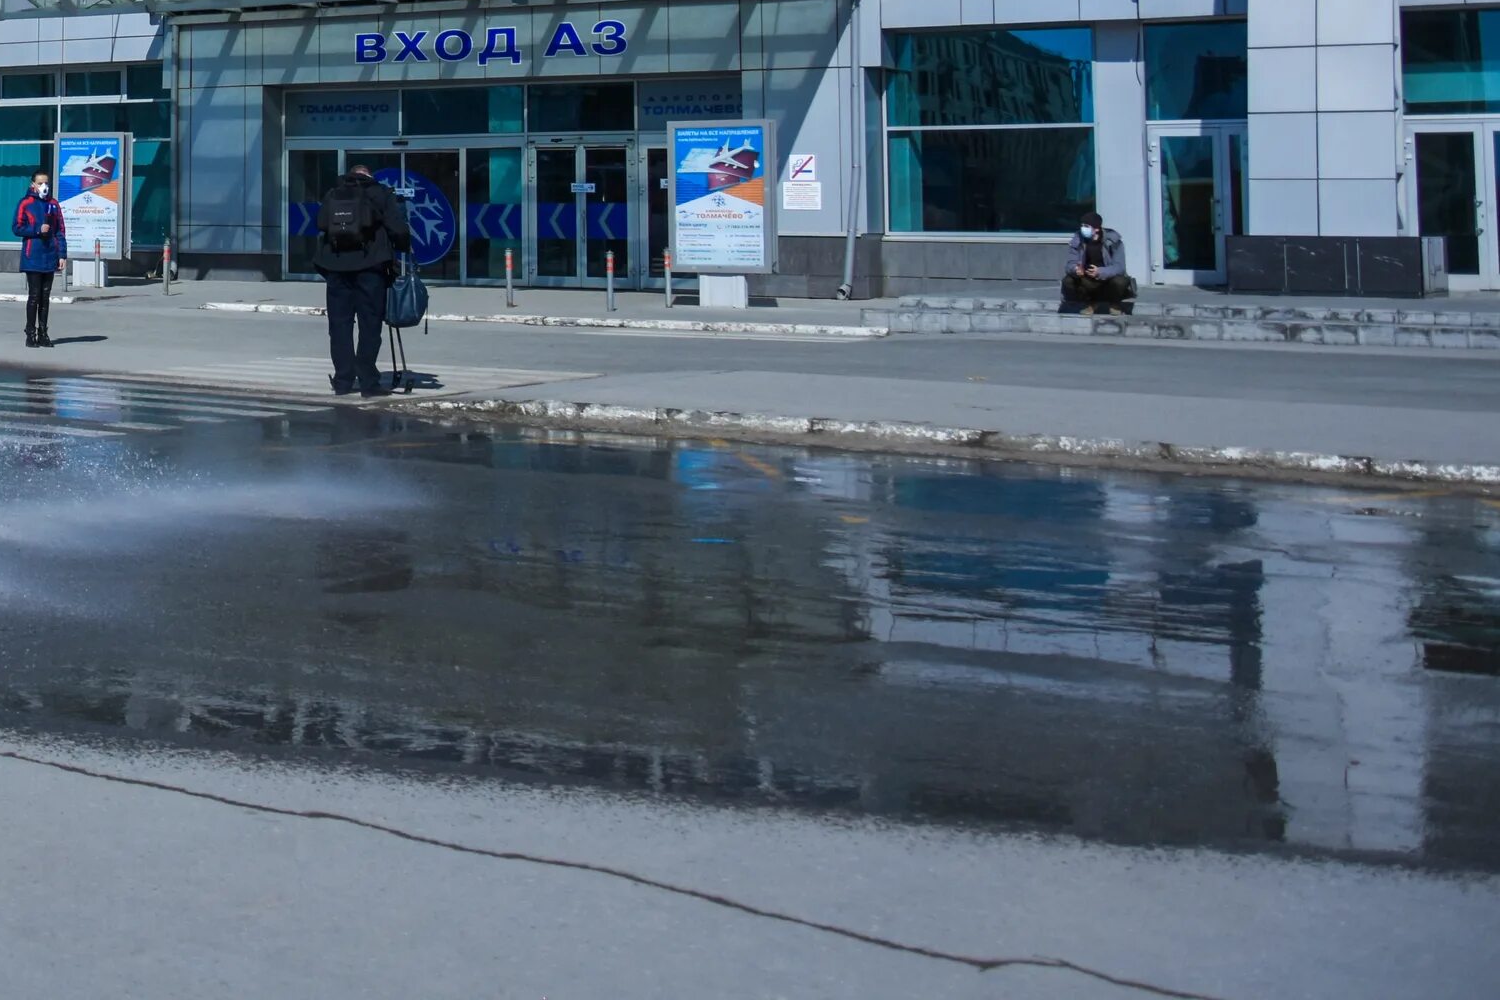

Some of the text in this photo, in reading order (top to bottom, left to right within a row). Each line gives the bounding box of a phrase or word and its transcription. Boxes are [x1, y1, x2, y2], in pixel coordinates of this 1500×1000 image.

[354, 19, 628, 67] ВХОД А3
[298, 103, 389, 114] TOLMACHEVO
